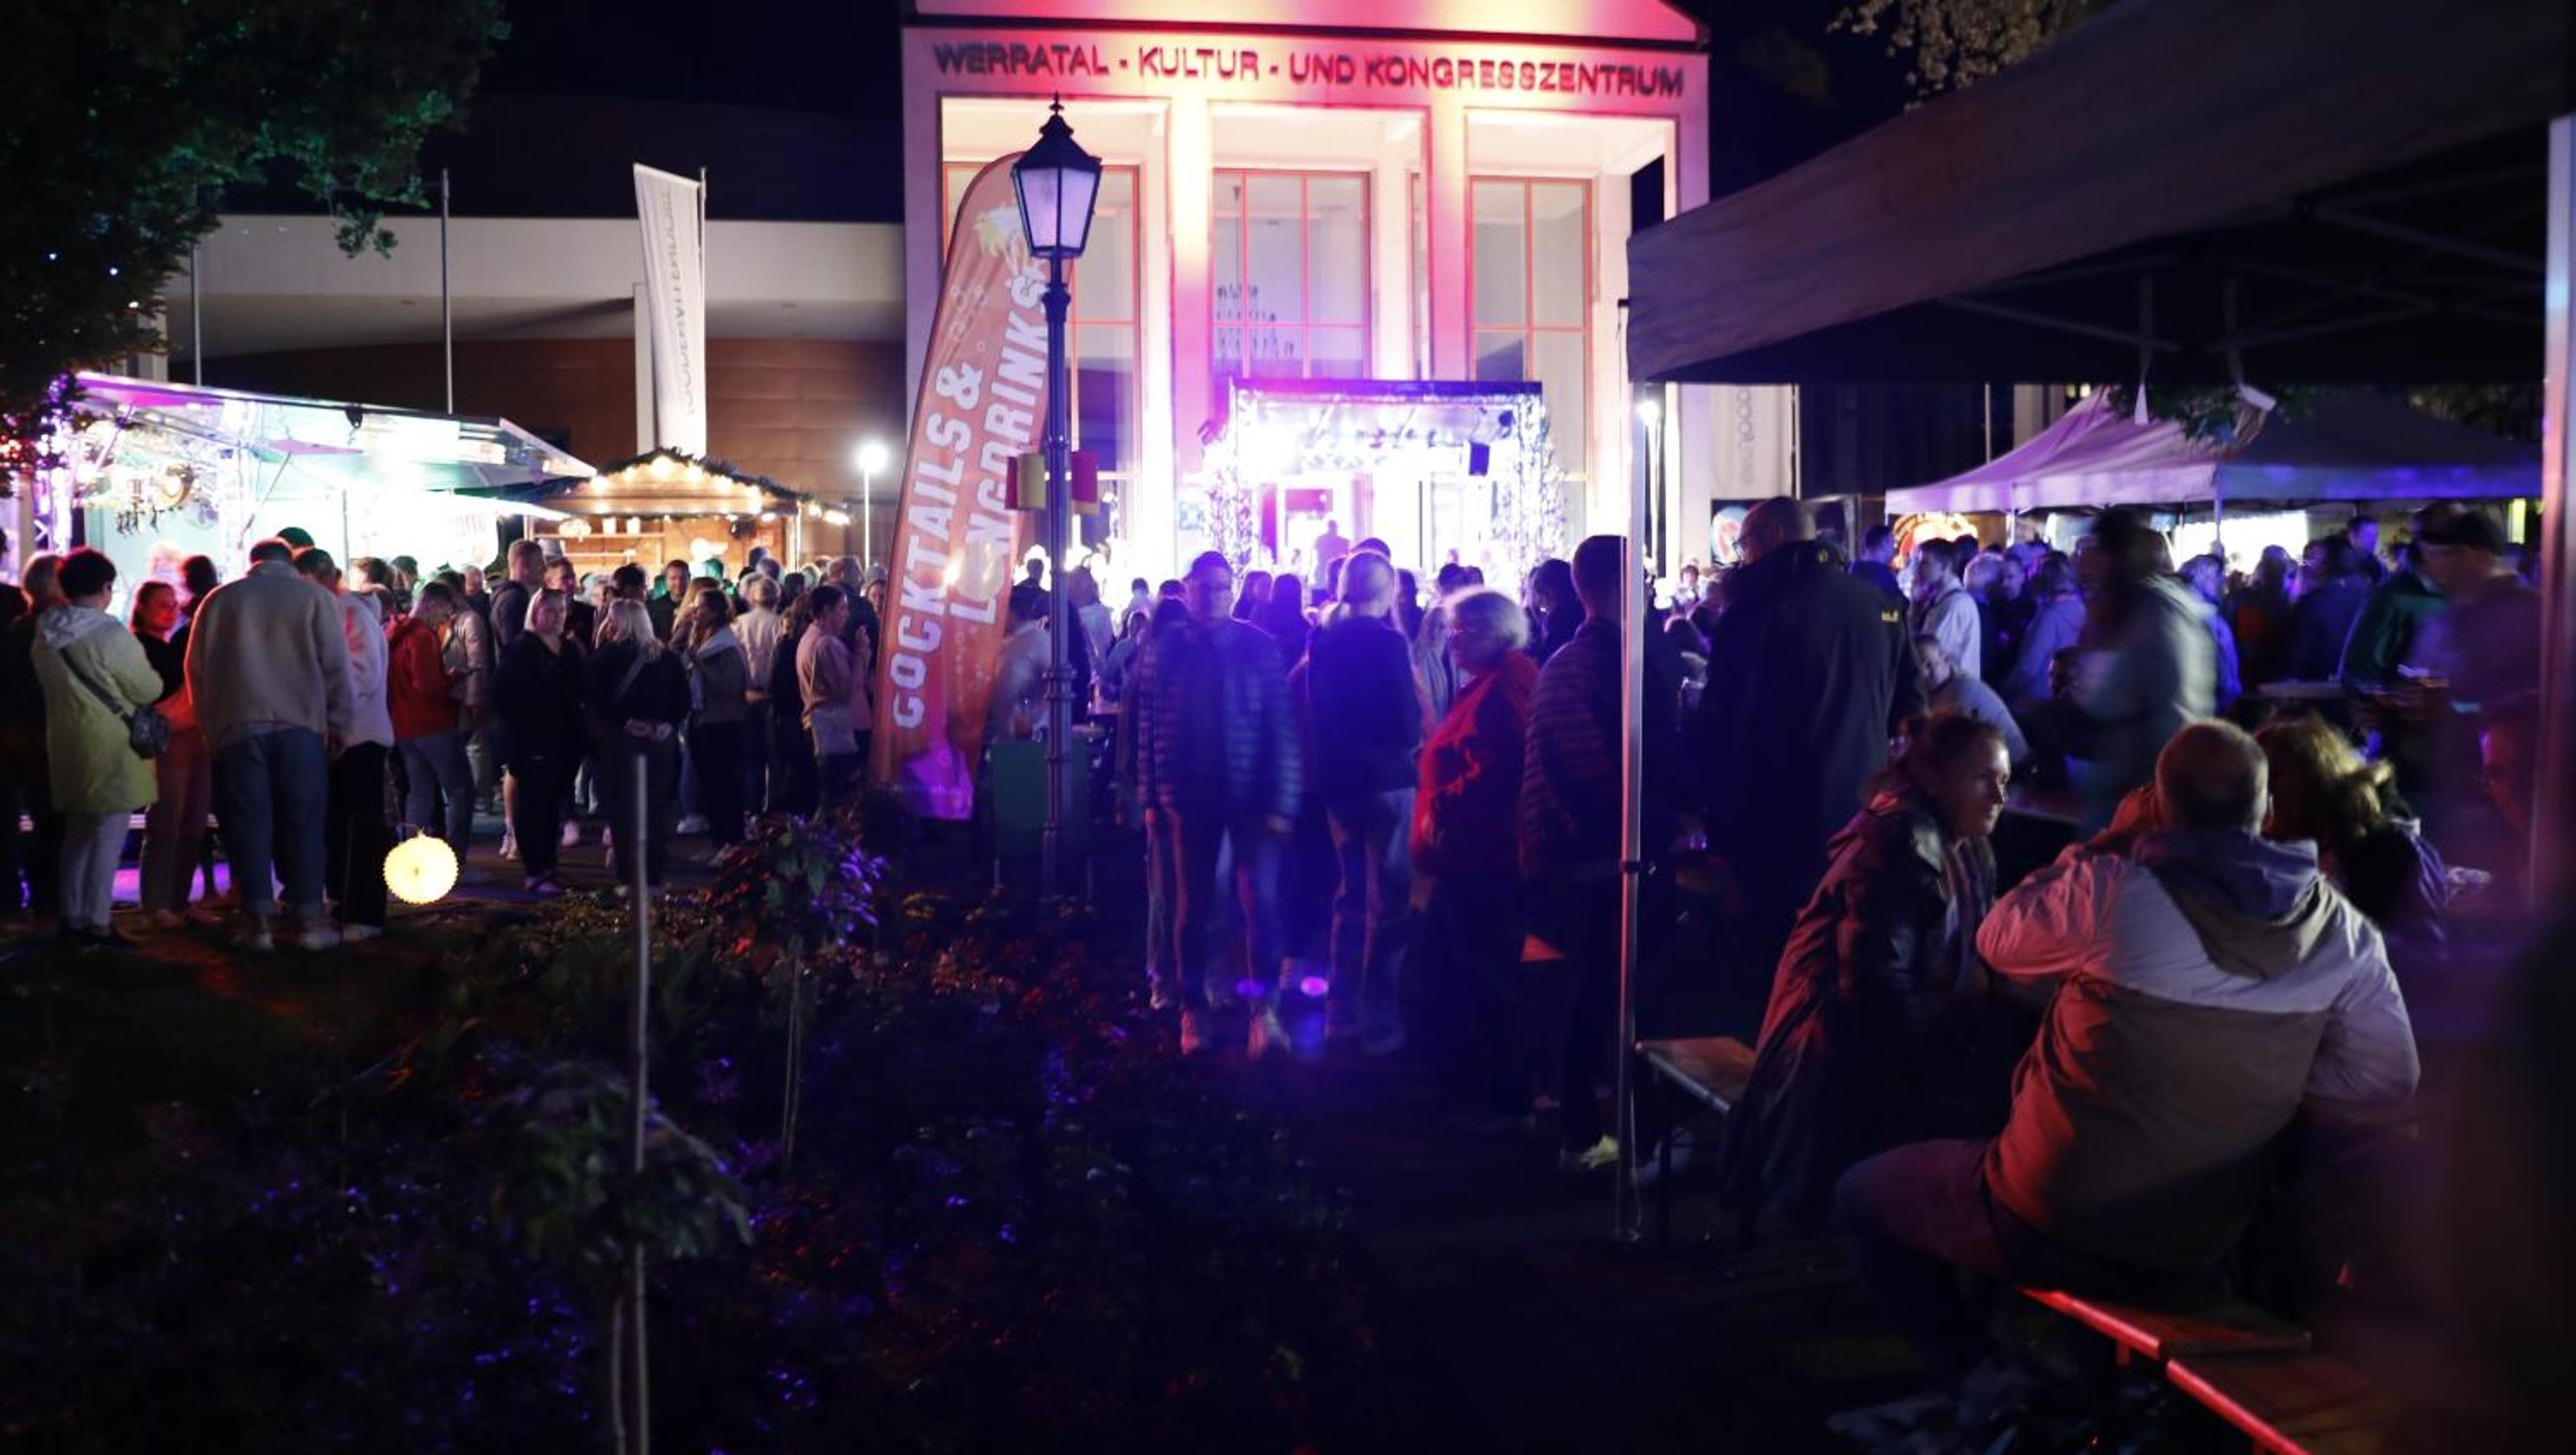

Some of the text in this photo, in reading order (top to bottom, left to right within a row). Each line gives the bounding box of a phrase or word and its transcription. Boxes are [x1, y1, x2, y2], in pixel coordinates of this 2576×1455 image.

[933, 42, 1108, 74] WERRATAL
[1139, 46, 1259, 81] KULTUR
[1289, 52, 1355, 85] UND
[1365, 55, 1684, 98] KONGRESSZENTRUM
[890, 362, 985, 729] COCKTAILS &
[950, 274, 1049, 624] LNGDRINKS
